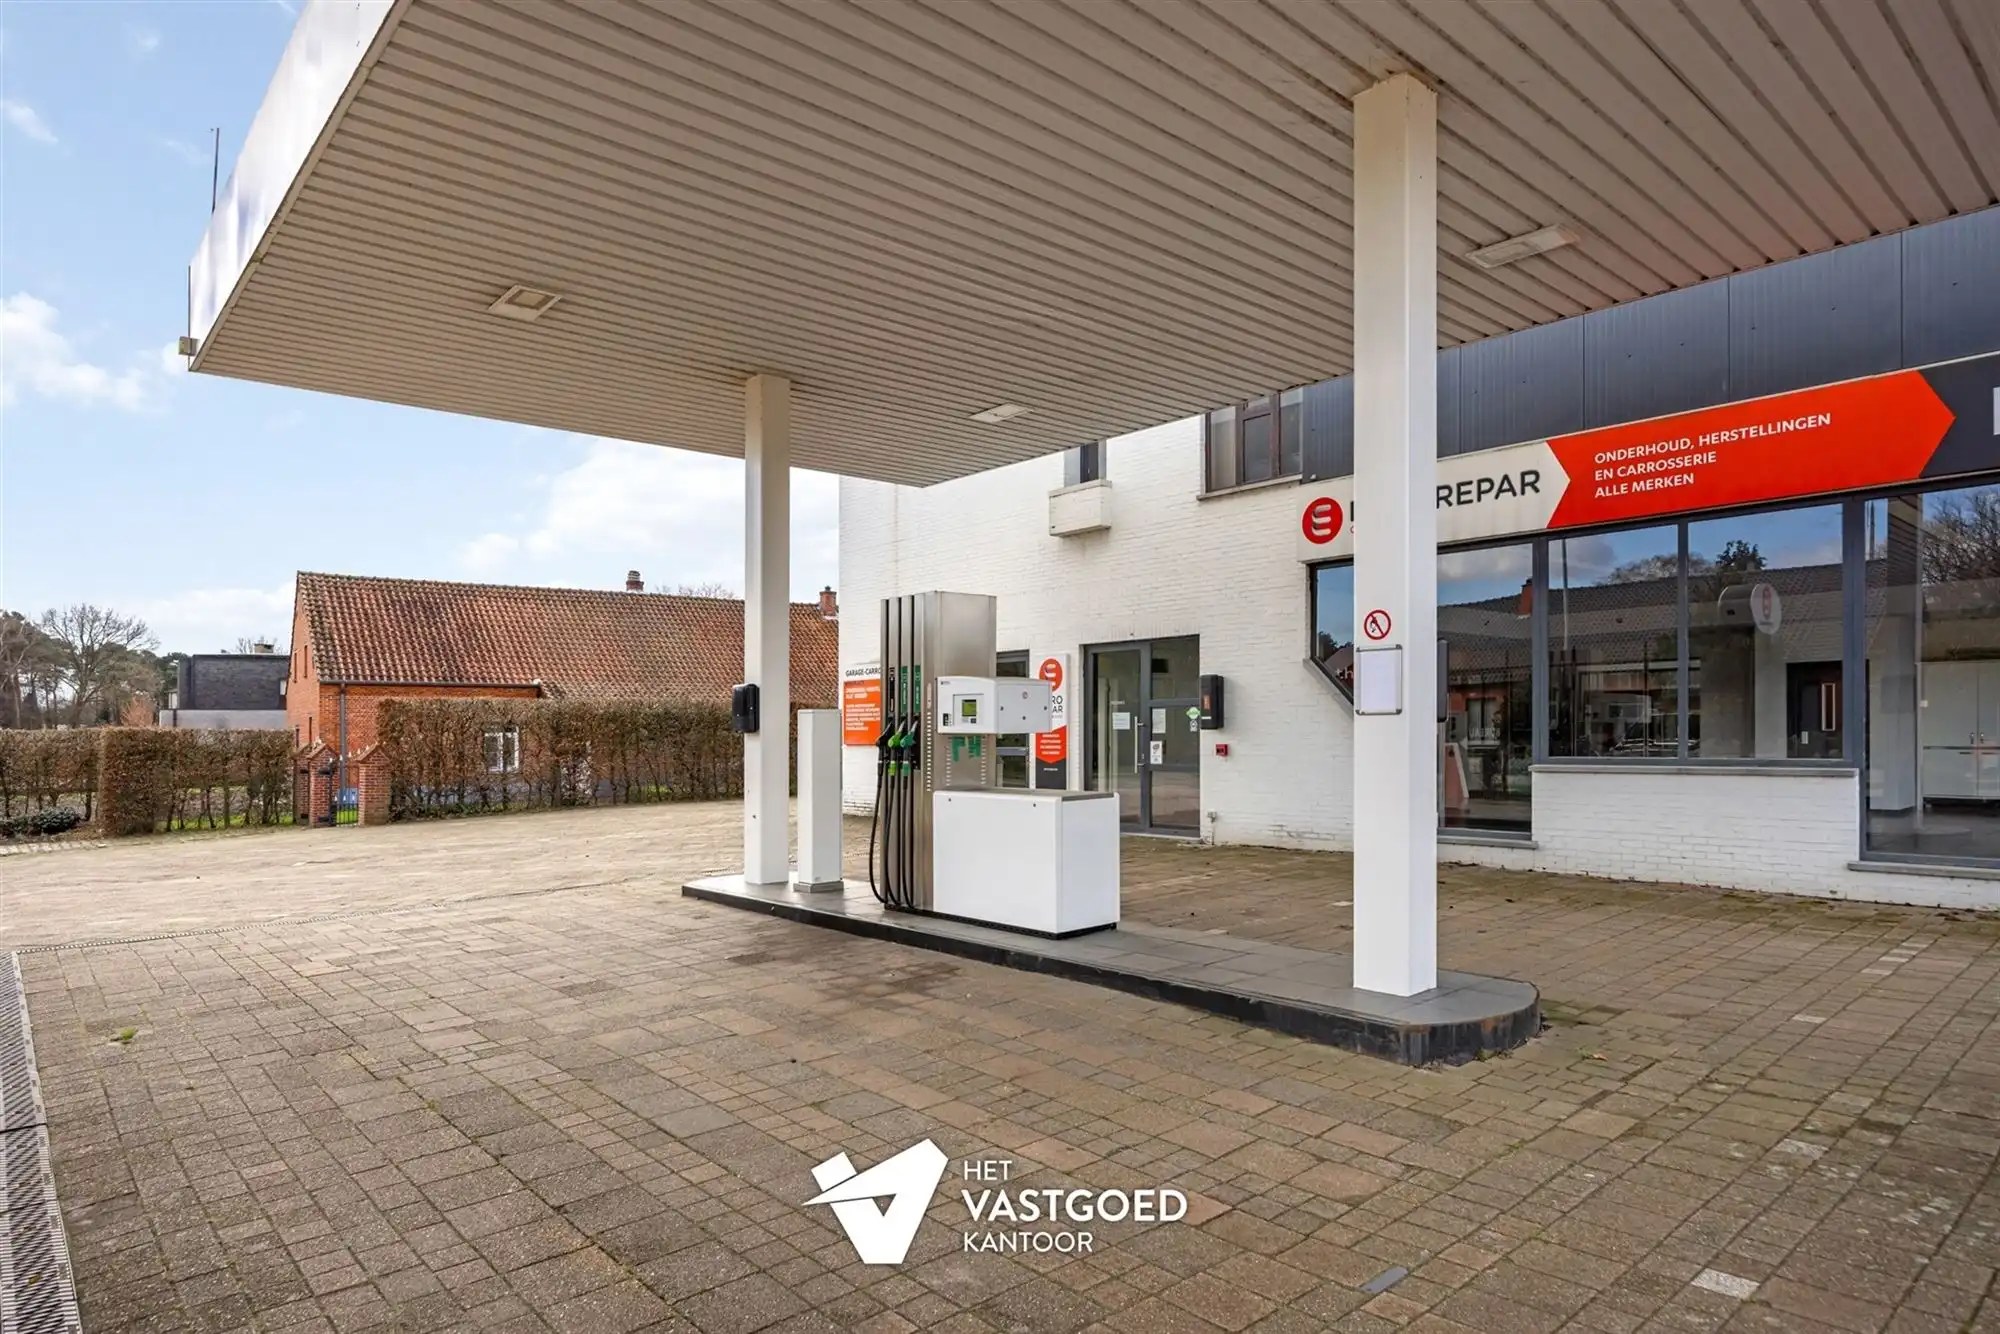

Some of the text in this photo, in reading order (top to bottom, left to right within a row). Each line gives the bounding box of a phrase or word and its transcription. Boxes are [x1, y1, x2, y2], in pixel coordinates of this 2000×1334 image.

[1595, 413, 1831, 464] ONDERHOUD, HERSTELLINGEN
[1595, 451, 1717, 481] EN CARROSSERIE
[1595, 473, 1694, 498] ALLE MERKEN
